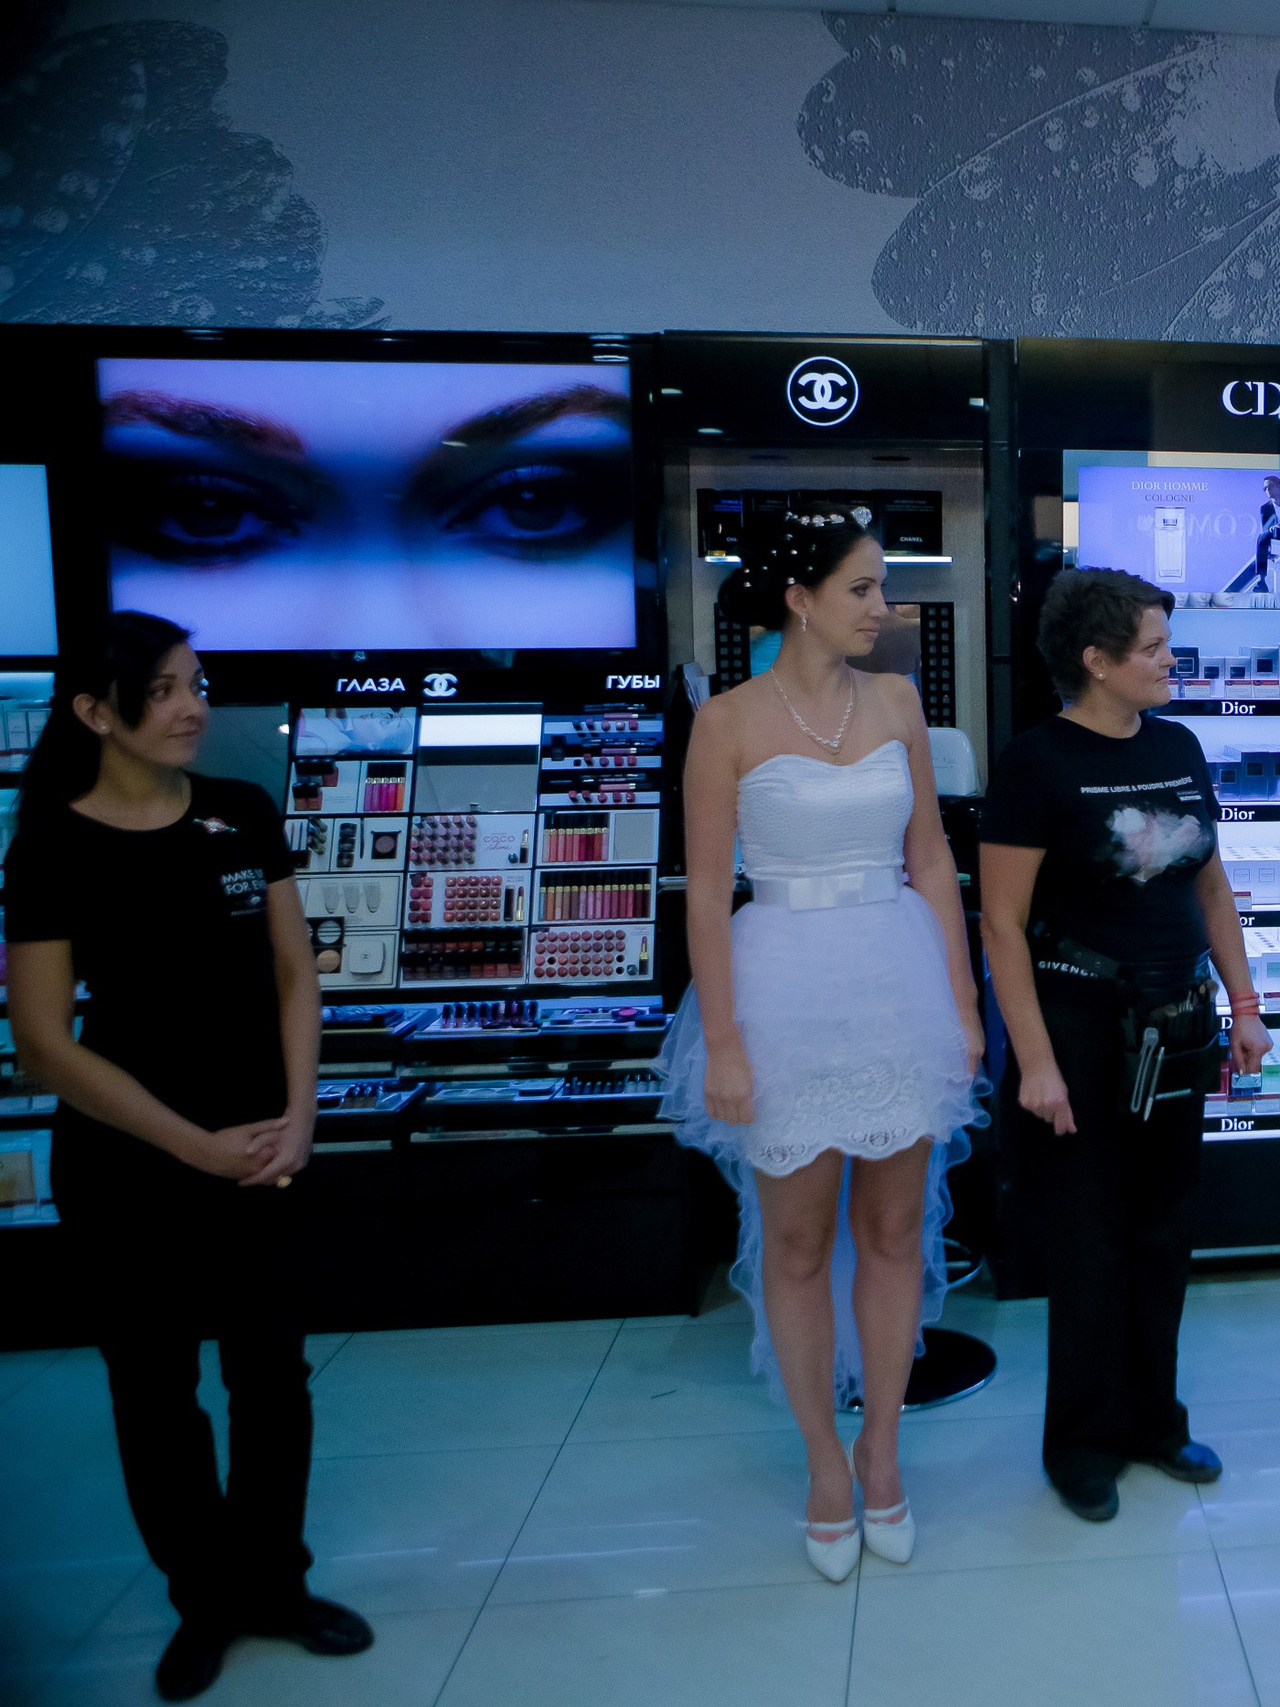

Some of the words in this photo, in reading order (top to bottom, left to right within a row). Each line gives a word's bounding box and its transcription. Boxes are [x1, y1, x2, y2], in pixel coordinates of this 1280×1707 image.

[1131, 481, 1161, 490] DIOR
[1163, 482, 1209, 492] HOMME
[1144, 494, 1195, 503] COLOGNE
[337, 677, 406, 692] ГЛАЗА
[606, 674, 661, 690] ГУБЫ
[1221, 701, 1256, 715] Dior
[1080, 786, 1110, 795] PRISME
[1110, 785, 1131, 793] LIBRE
[1137, 782, 1165, 791] POUDRE
[1220, 807, 1256, 821] Dior
[221, 869, 255, 884] MAKE
[224, 881, 252, 896] FOR
[1037, 960, 1099, 978] GIVENC
[1220, 1118, 1255, 1132] Dior
